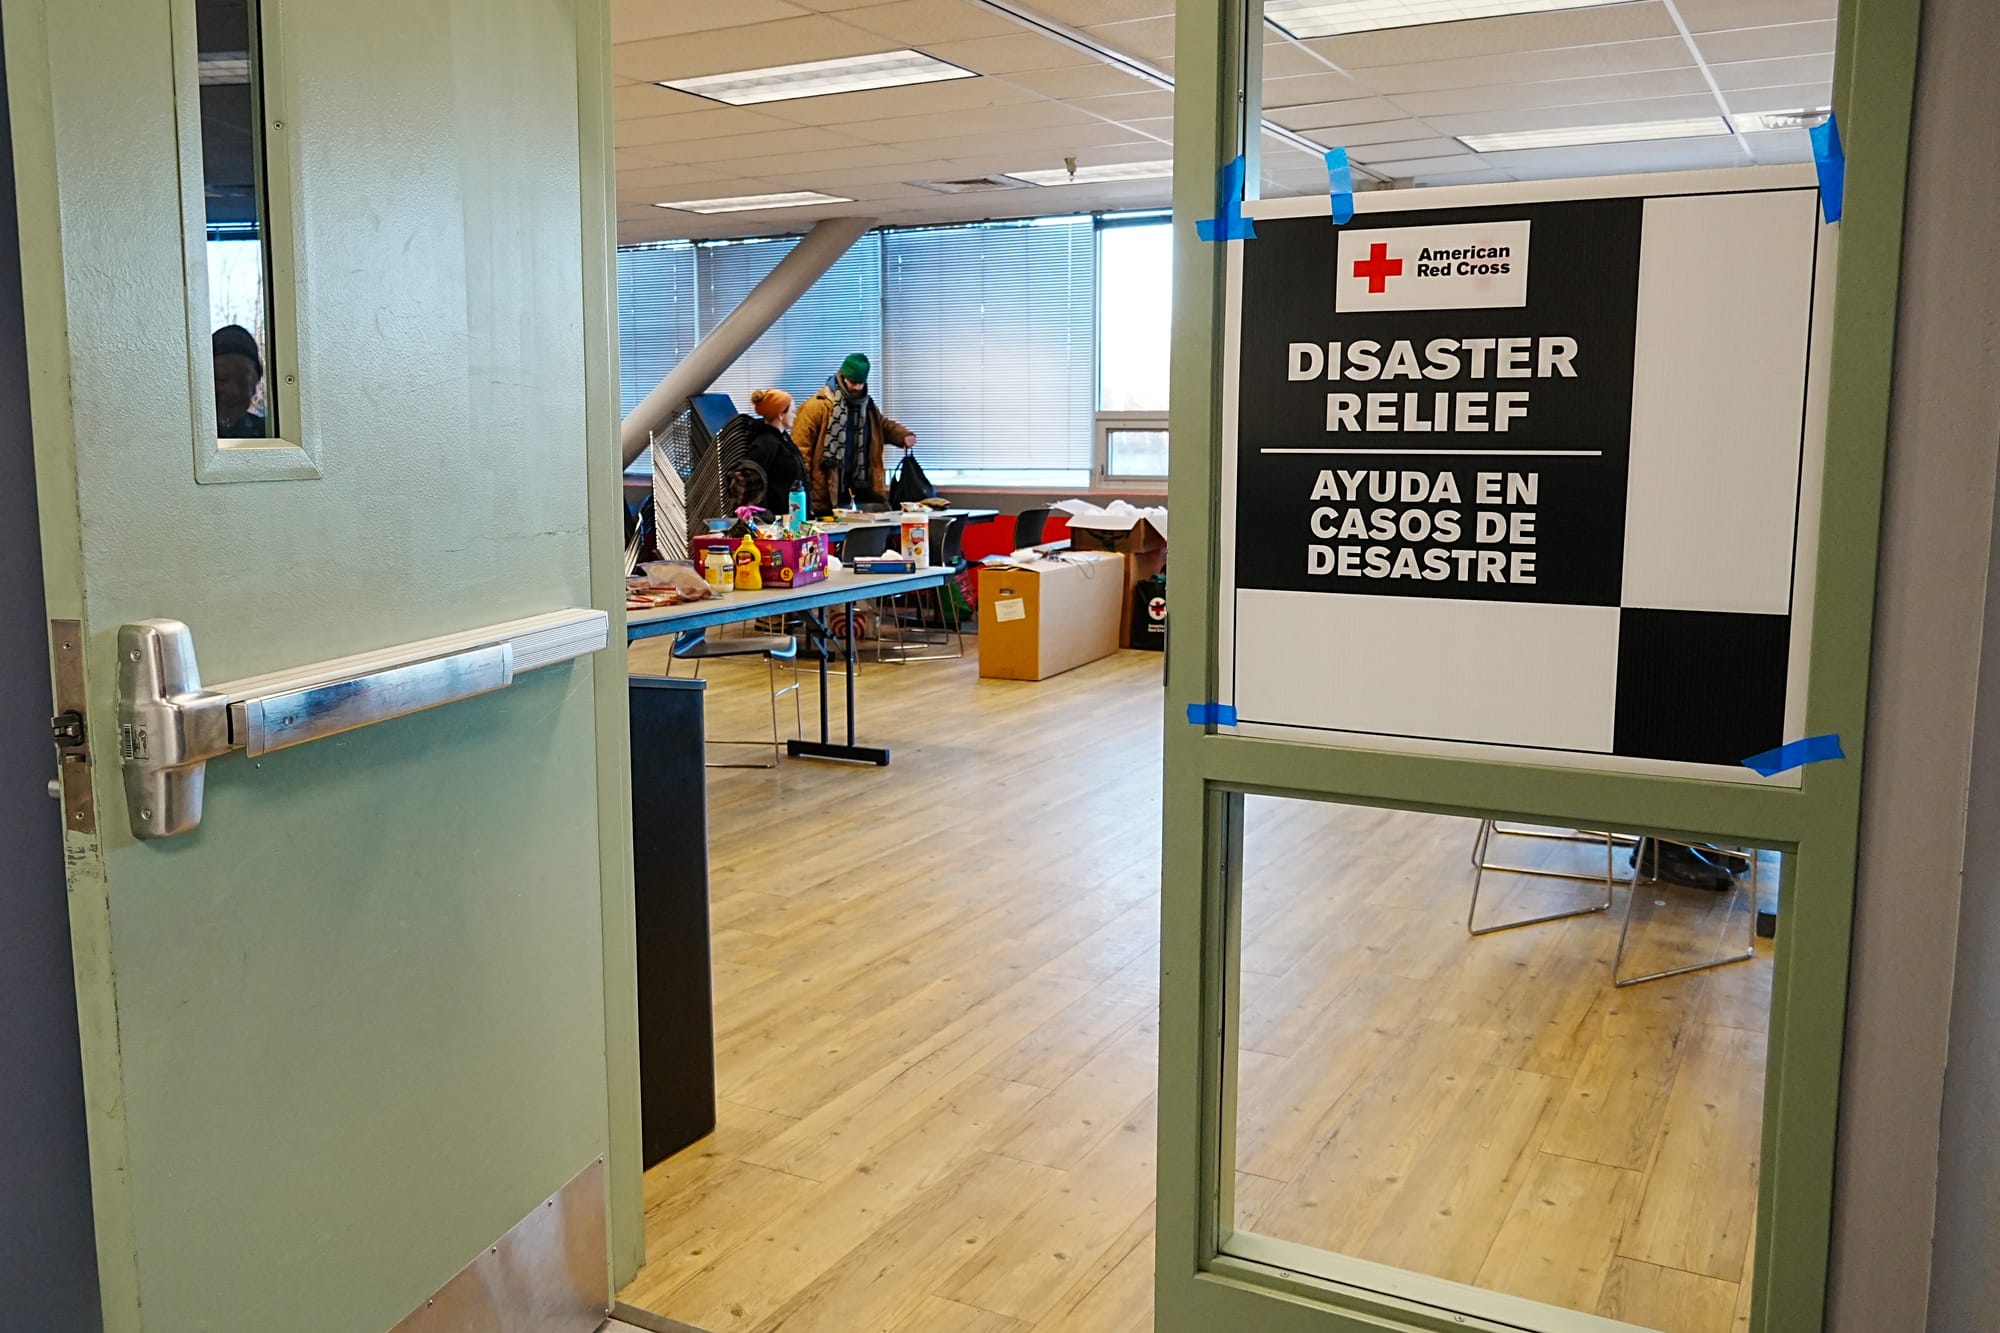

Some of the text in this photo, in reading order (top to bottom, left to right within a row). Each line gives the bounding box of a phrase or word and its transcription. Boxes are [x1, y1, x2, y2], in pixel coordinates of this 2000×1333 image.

[1417, 261, 1511, 277] Red Cross
[1418, 245, 1510, 262] American
[1287, 336, 1578, 382] DISASTER
[1326, 391, 1530, 432] RELIEF
[1310, 469, 1539, 505] AYUDA EN
[1310, 507, 1537, 545] CASOS DE
[1307, 544, 1537, 585] DESASTRE
